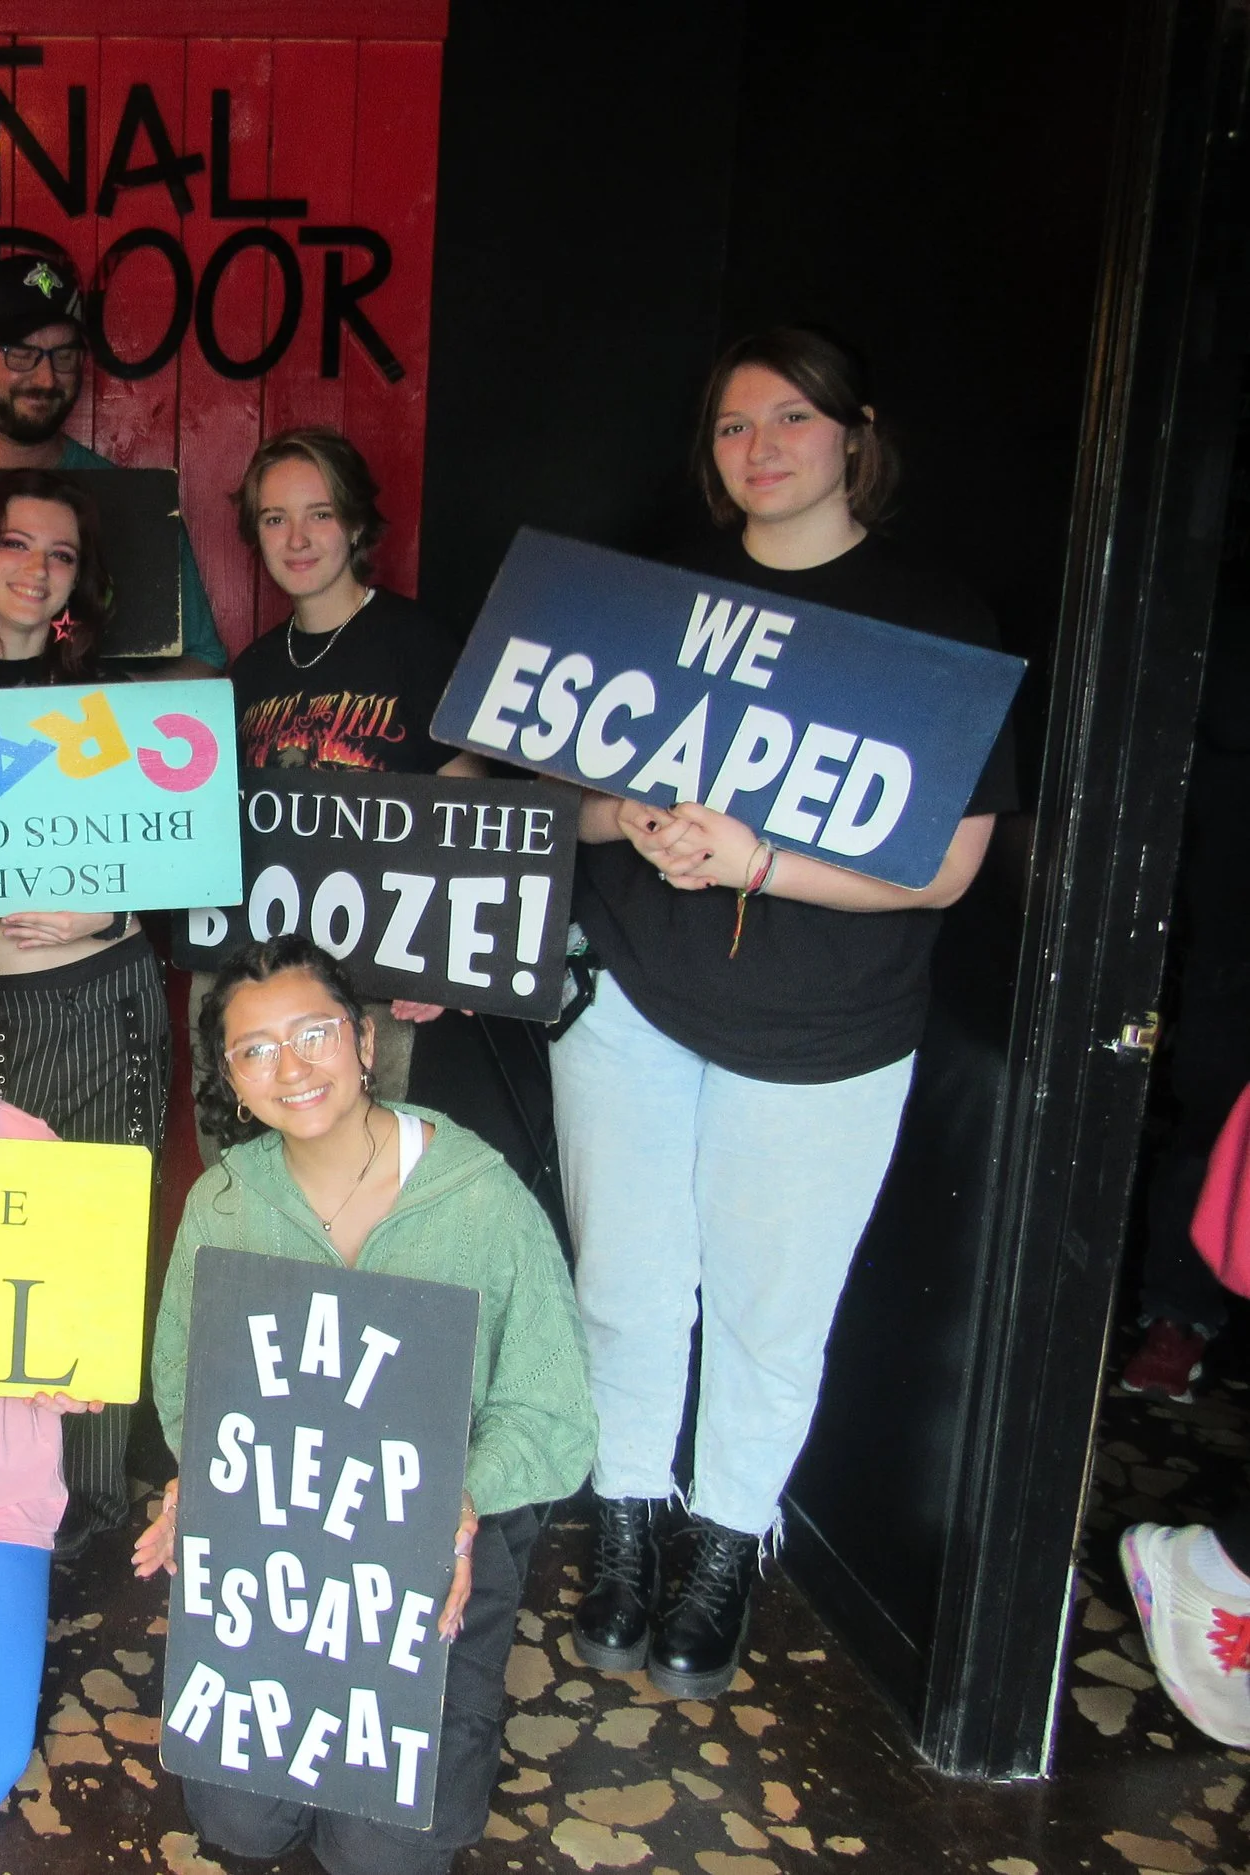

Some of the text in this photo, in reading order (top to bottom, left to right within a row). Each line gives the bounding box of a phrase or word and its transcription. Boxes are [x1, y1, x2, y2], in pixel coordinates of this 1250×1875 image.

[676, 592, 796, 689] WE
[466, 637, 912, 857] ESCAPED
[25, 809, 196, 849] BRINGS
[239, 789, 554, 855] OUND THE
[247, 1291, 401, 1410] EAT
[208, 1411, 421, 1542] SLEEP
[182, 1535, 435, 1674] ESCAPE
[166, 1660, 430, 1807] REPEAT
